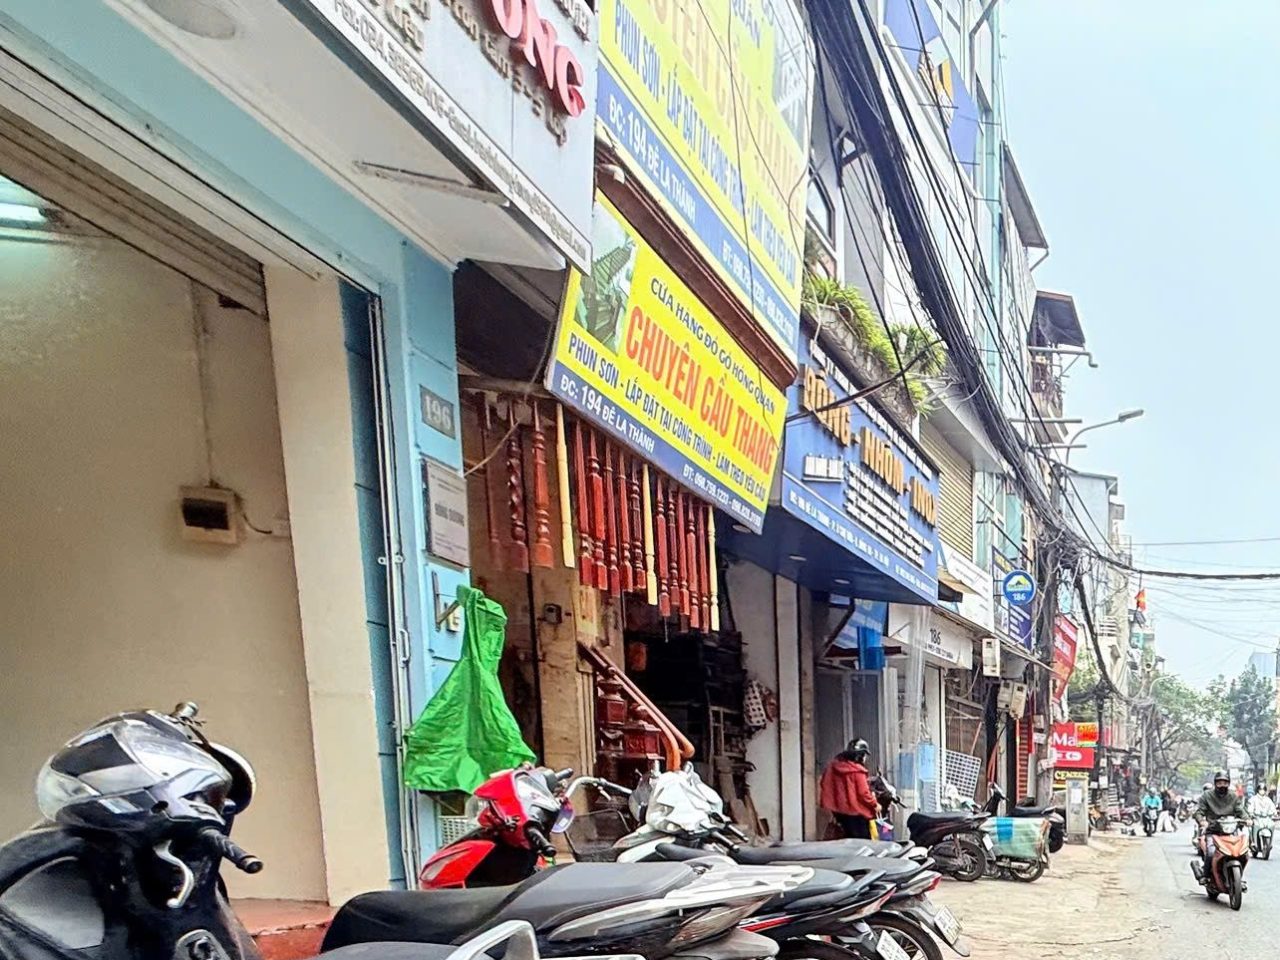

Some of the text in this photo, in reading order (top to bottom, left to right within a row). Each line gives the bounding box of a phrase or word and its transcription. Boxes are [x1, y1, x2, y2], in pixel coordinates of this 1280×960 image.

[628, 111, 648, 160] 194
[424, 394, 452, 431] 196
[560, 373, 579, 400] ĐC:
[580, 384, 602, 416] 194
[615, 412, 629, 434] LA
[628, 417, 656, 453] THÀNH
[567, 332, 599, 373] PHUN
[598, 356, 621, 390] SƠN
[624, 376, 643, 406] LẮP
[642, 389, 660, 422] ĐẶT
[659, 405, 674, 433] TẠI
[625, 305, 702, 412] CHUYÊN
[699, 372, 735, 439] CẦU
[731, 405, 777, 476] THANG
[860, 425, 905, 496] NHÔM
